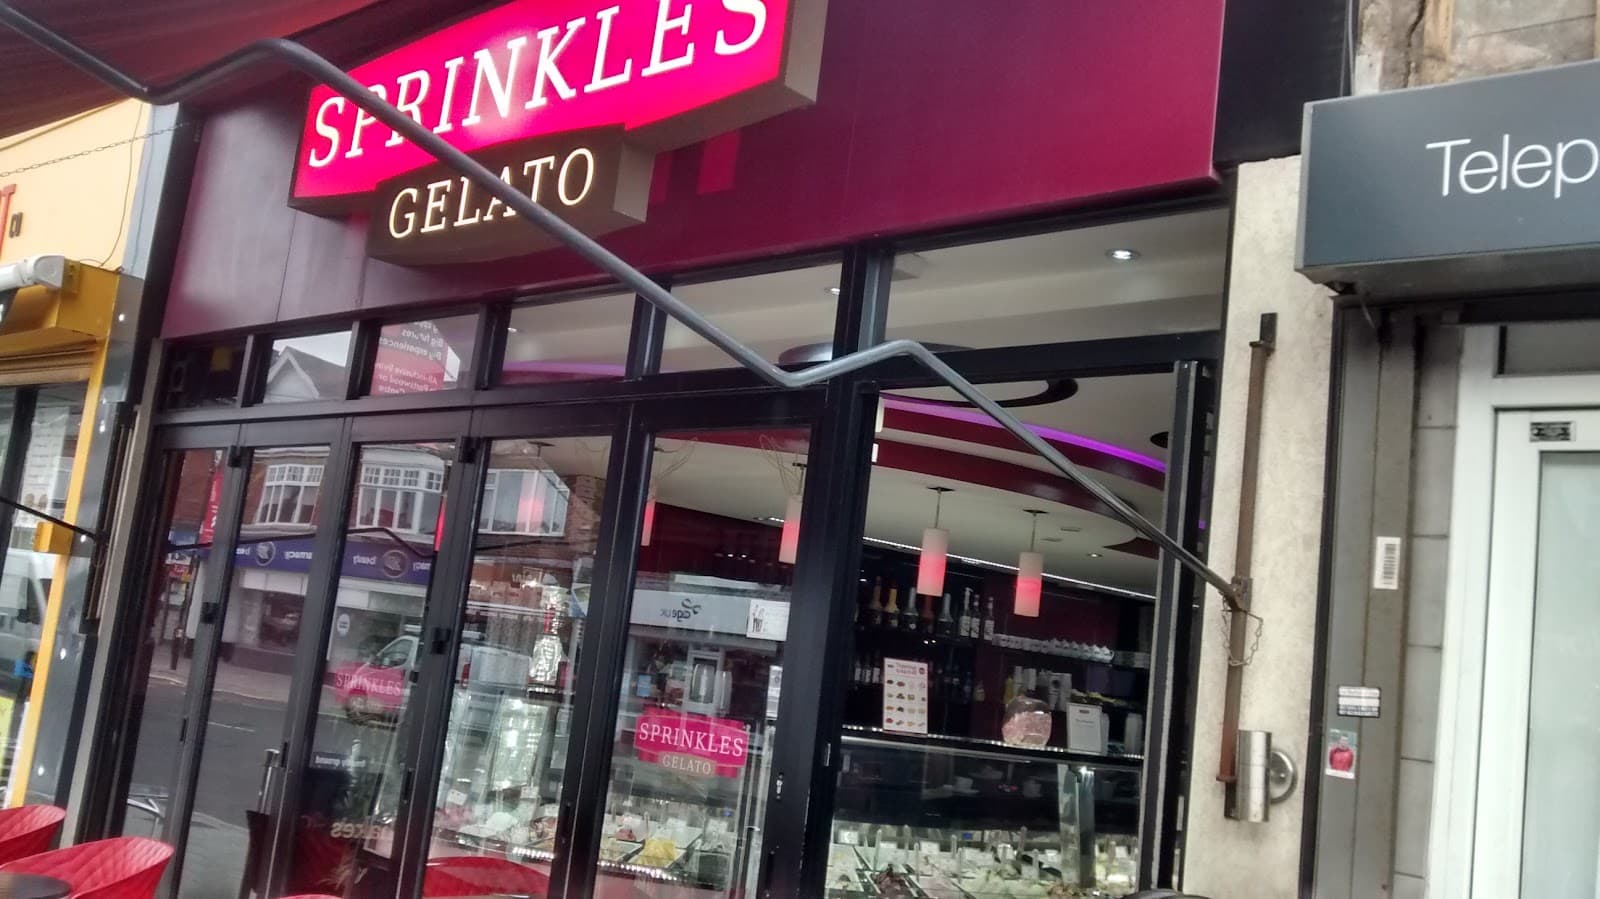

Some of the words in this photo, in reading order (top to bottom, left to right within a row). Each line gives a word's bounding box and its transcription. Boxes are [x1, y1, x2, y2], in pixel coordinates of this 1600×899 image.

[308, 0, 768, 168] SPRINKLES
[1425, 133, 1599, 199] Telep
[388, 147, 597, 239] GELATO
[336, 671, 402, 697] SPRINKLES
[639, 721, 744, 758] SPRINKLES
[661, 754, 712, 776] GELATO
